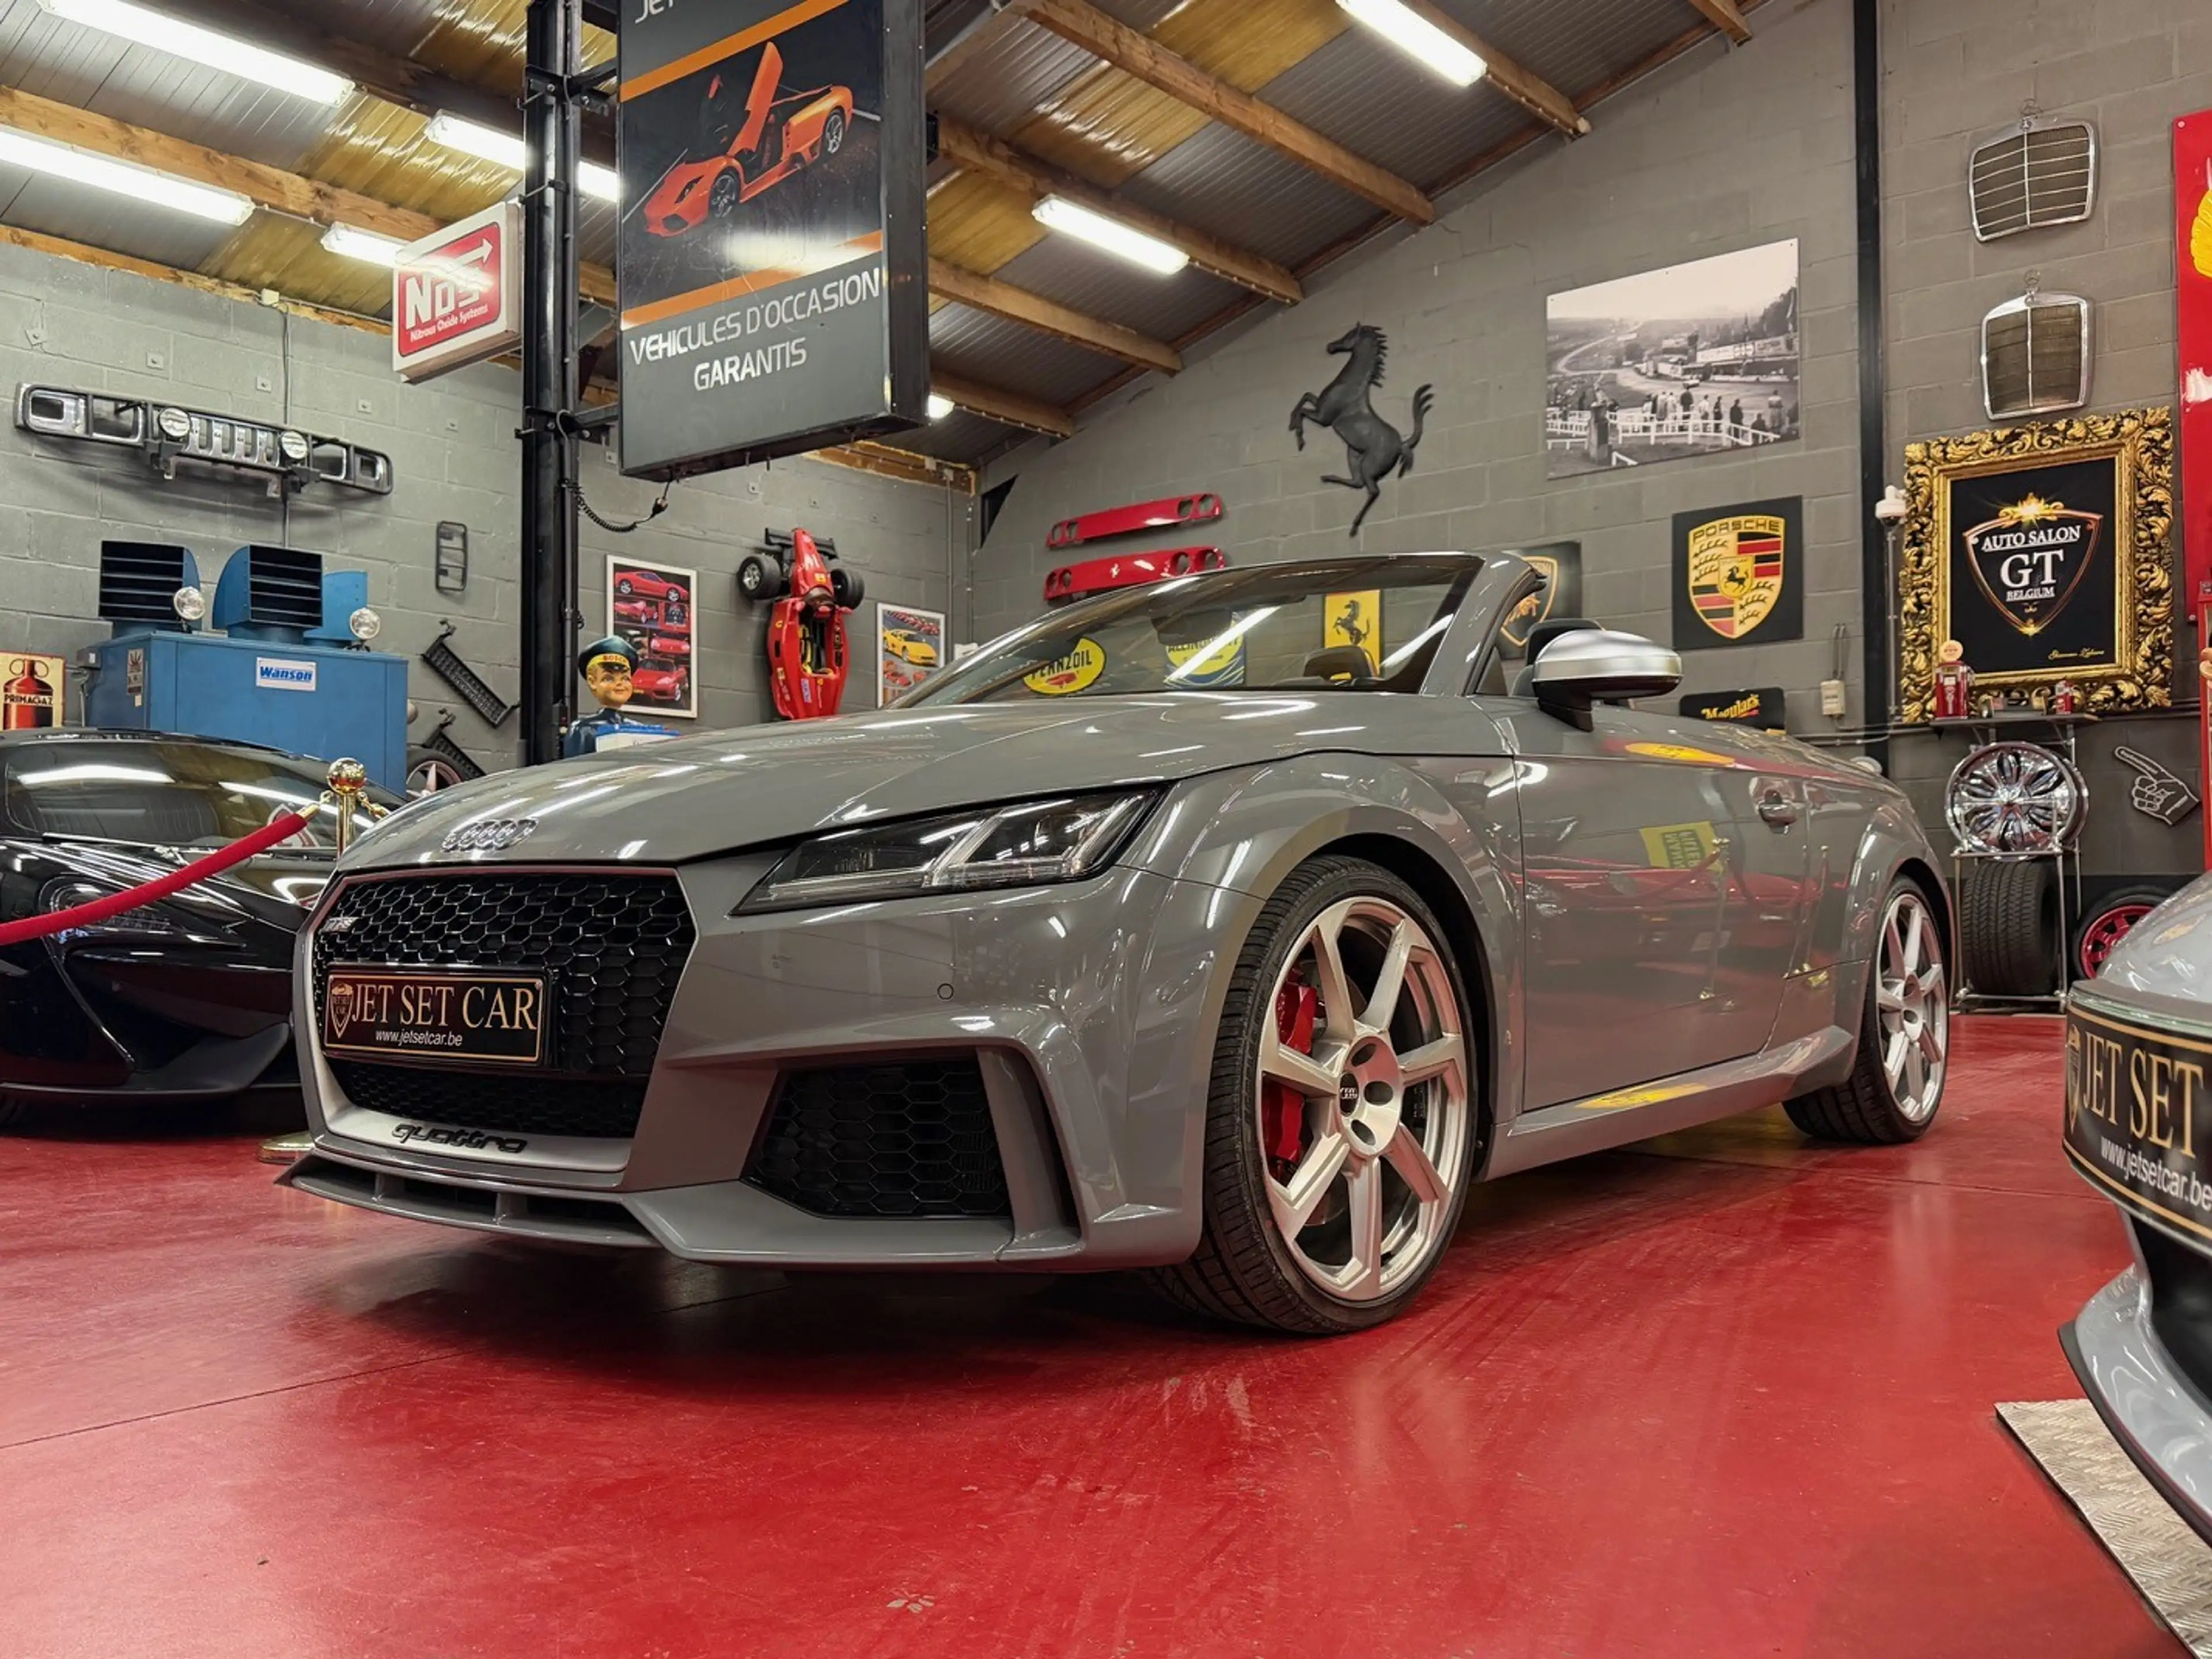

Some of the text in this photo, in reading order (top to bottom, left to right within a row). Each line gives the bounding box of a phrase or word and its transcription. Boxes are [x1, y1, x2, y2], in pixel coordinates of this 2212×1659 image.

[635, 0, 673, 24] JE
[410, 325, 436, 342] Nitrous
[460, 304, 488, 325] Systems
[630, 267, 880, 366] VEHICULES D'OCCASION
[694, 337, 807, 391] GARANTIS
[1692, 519, 1780, 543] PORSCHE
[1982, 525, 2081, 551] AUTO SALON
[2000, 549, 2065, 588] GT
[2006, 586, 2055, 601] BELGIUM
[260, 666, 313, 681] Wanson
[4, 694, 53, 706] PRIMAGAZ
[352, 983, 537, 1030] JET SET CAR
[375, 1028, 463, 1047] www.jetsetcar.be
[2083, 1031, 2123, 1126] JET
[2130, 1047, 2204, 1160] SET
[391, 1123, 528, 1154] quattro
[2100, 1135, 2212, 1211] www.jetsetcar.be
